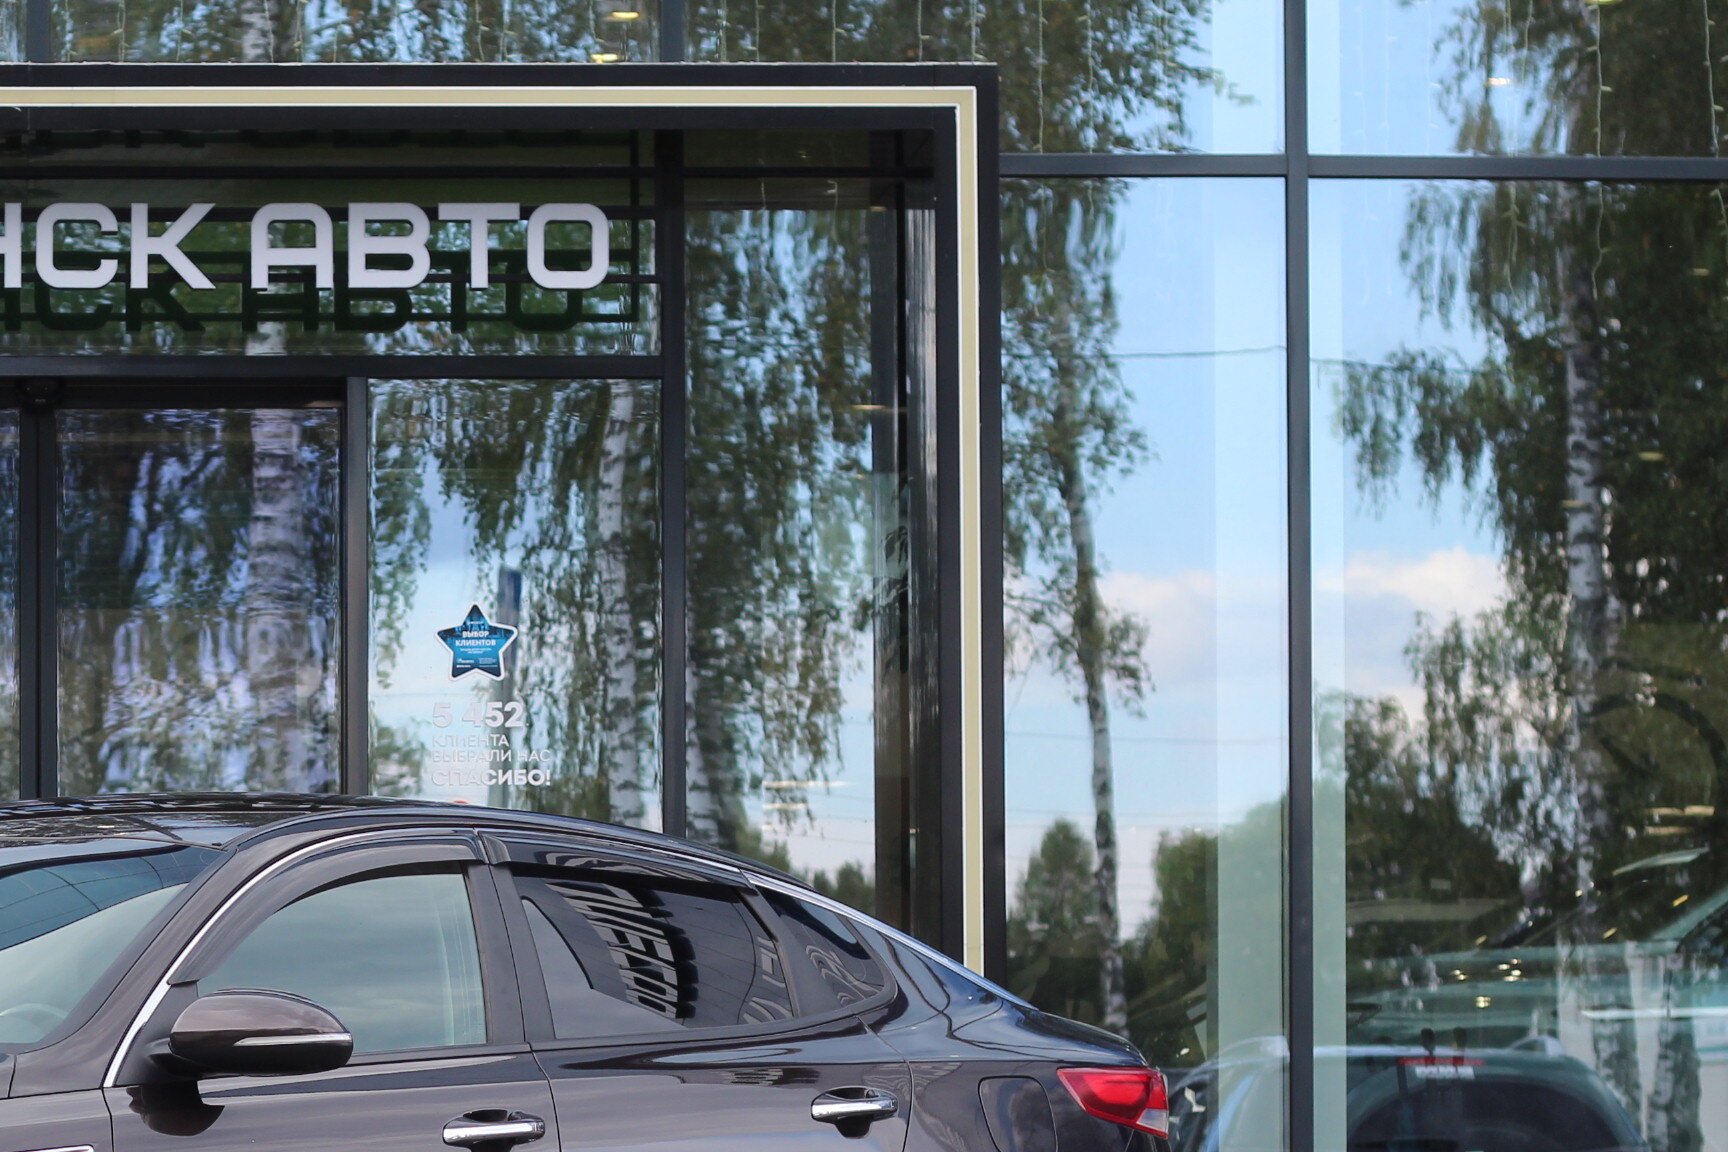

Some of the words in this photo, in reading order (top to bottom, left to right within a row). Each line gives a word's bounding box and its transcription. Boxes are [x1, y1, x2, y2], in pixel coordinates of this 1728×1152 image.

[250, 201, 611, 290] АВТО
[462, 630, 490, 638] ВЫБОР
[455, 639, 497, 647] КЛИЕНТОВ
[432, 702, 452, 728] 5
[432, 734, 509, 747] КЛИЕНТА
[432, 749, 512, 762] ВЫБРАЛИ
[517, 749, 551, 762] НАС
[432, 769, 551, 786] СПАСИБО!
